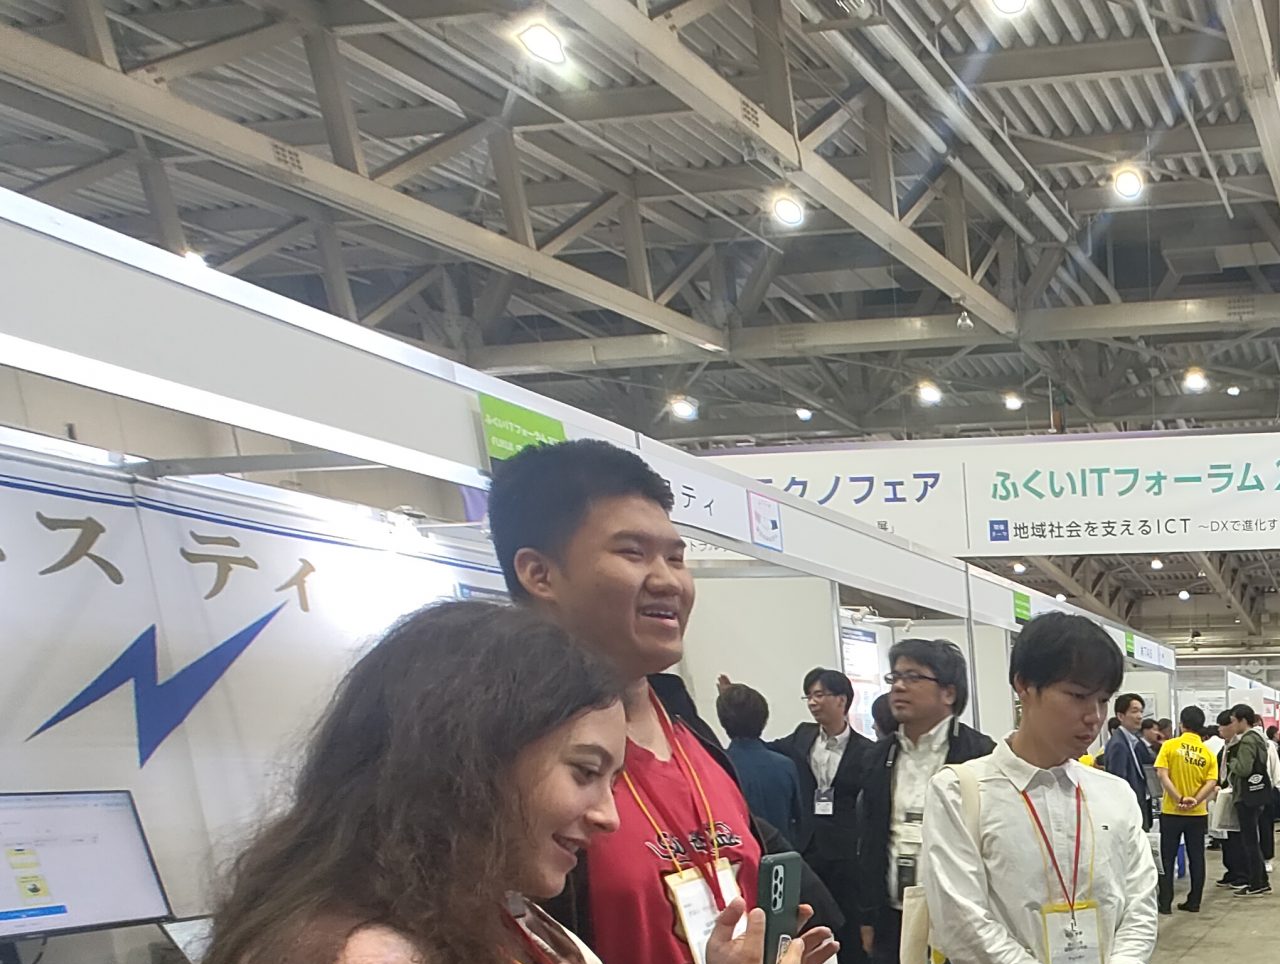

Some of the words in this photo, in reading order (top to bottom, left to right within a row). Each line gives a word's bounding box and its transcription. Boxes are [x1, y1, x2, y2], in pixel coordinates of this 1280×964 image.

[756, 471, 941, 505] クノフェア
[991, 463, 1265, 501] ふくいITフォーラム
[1013, 518, 1191, 540] 地域社会を支えるICT
[0, 510, 317, 613] スティ
